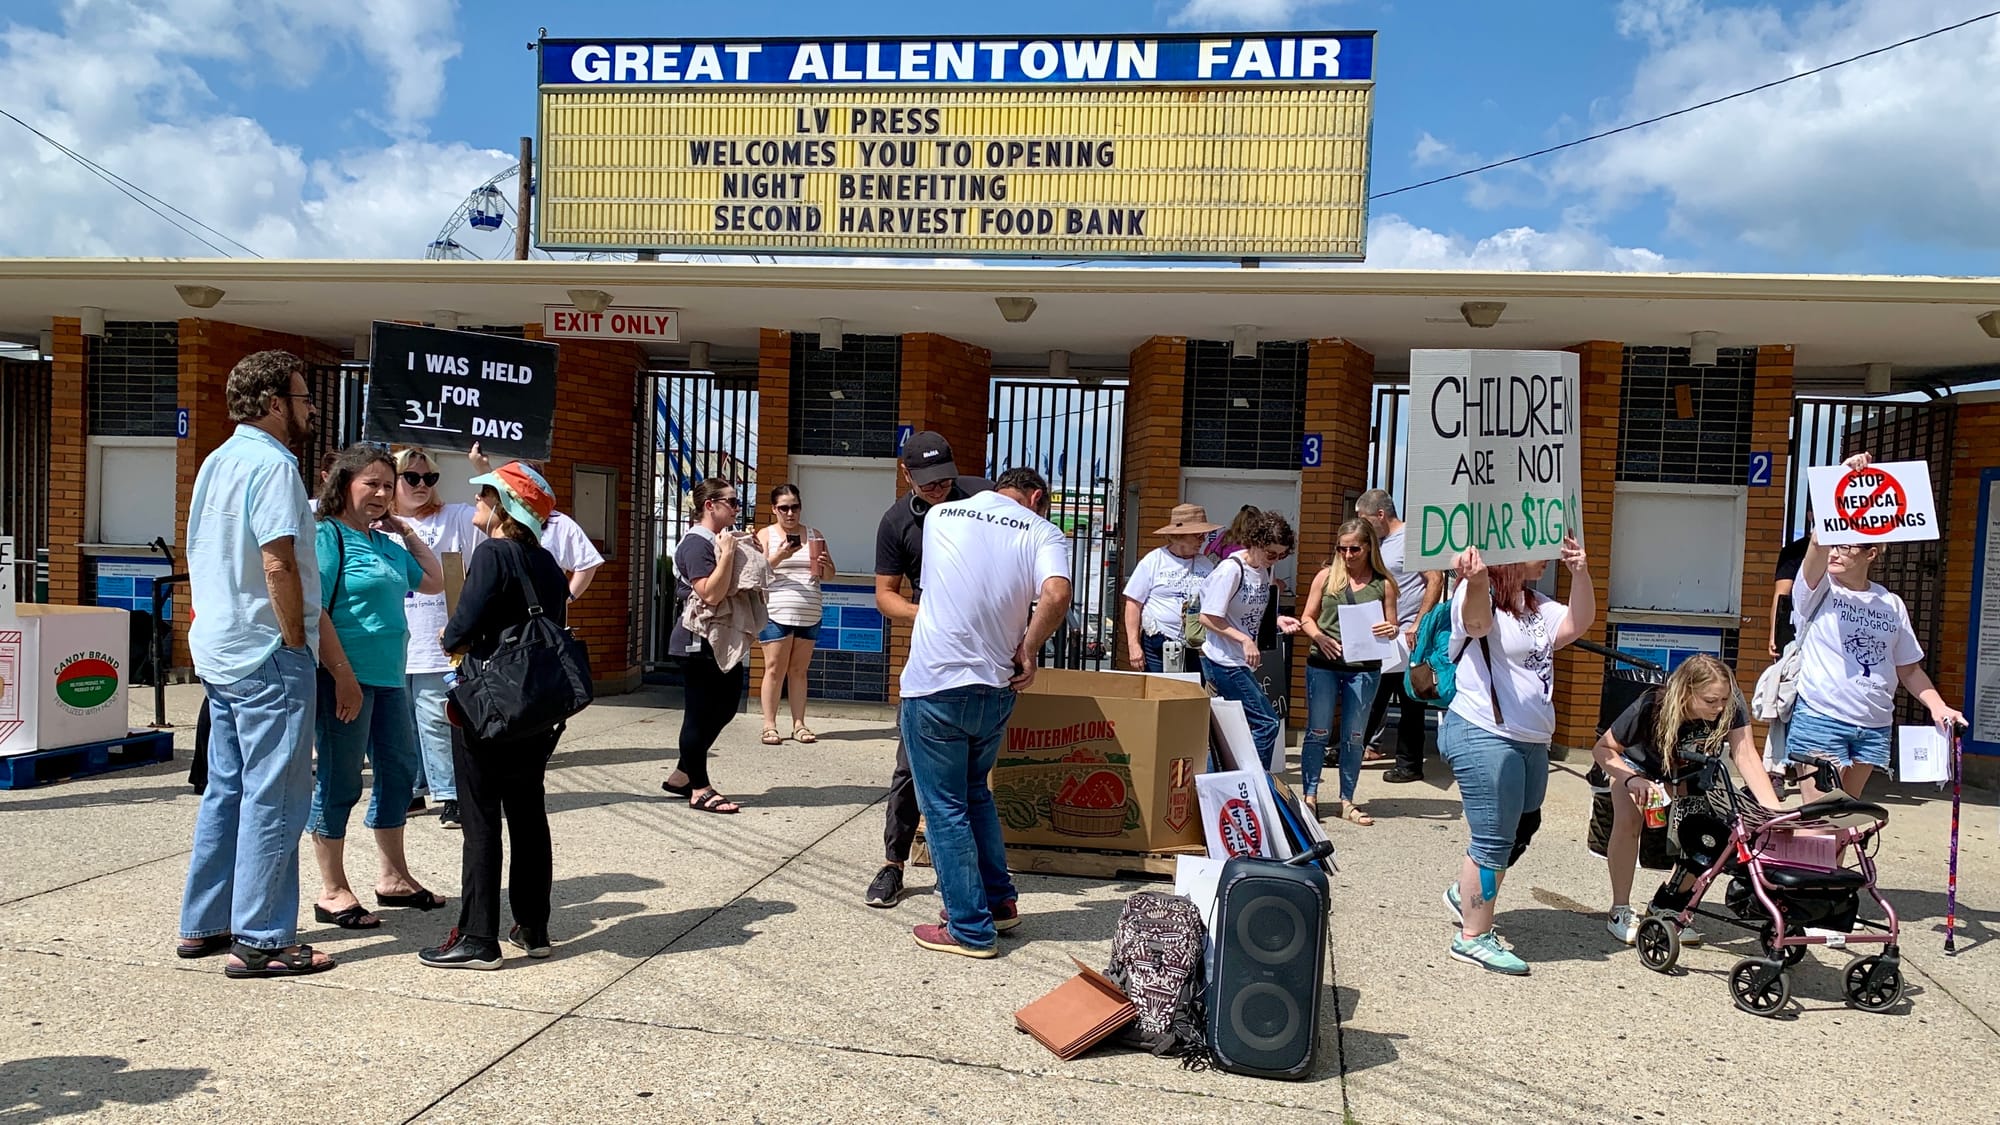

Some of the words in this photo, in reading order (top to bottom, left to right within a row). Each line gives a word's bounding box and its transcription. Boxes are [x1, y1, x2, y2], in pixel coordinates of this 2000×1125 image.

[571, 43, 762, 81] GREAT
[788, 39, 1158, 80] ALLENTOWN
[1198, 37, 1342, 78] FAIR
[796, 108, 829, 133] LV
[851, 108, 940, 133] PRESS
[689, 141, 836, 166] WELCOMES
[858, 141, 916, 166] YOU
[935, 141, 971, 166] TO
[986, 141, 1115, 167] OPENING
[723, 173, 804, 199] NIGHT
[840, 174, 1006, 200] BENEFITING
[714, 205, 821, 231] SECOND
[839, 207, 966, 233] HARVEST
[980, 208, 1053, 235] FOOD
[1066, 208, 1146, 236] BANK
[554, 312, 603, 332] EXIT
[611, 314, 669, 335] ONLY
[408, 351, 414, 370] I
[425, 354, 469, 375] WAS
[482, 360, 532, 385] HELD
[441, 385, 480, 407] FOR
[1431, 375, 1573, 438] CHILDREN
[178, 411, 187, 435] 6
[404, 400, 444, 427] 34
[471, 417, 523, 441] DAYS
[900, 428, 910, 447] 4
[1305, 437, 1319, 465] 3
[1518, 444, 1564, 483] NOT
[1451, 450, 1495, 485] ARE
[1752, 455, 1768, 484] 2
[1848, 473, 1885, 488] STOP
[1837, 493, 1903, 510] MEDICAL
[939, 508, 1030, 531] PMRGLV.COM
[1421, 502, 1515, 556] DOLLAR
[1824, 512, 1926, 532] KIDNAPPINGS
[54, 652, 85, 676] CANDY
[89, 651, 119, 669] BRAND
[1007, 720, 1115, 752] WATERMELONS
[1222, 818, 1235, 850] STOP
